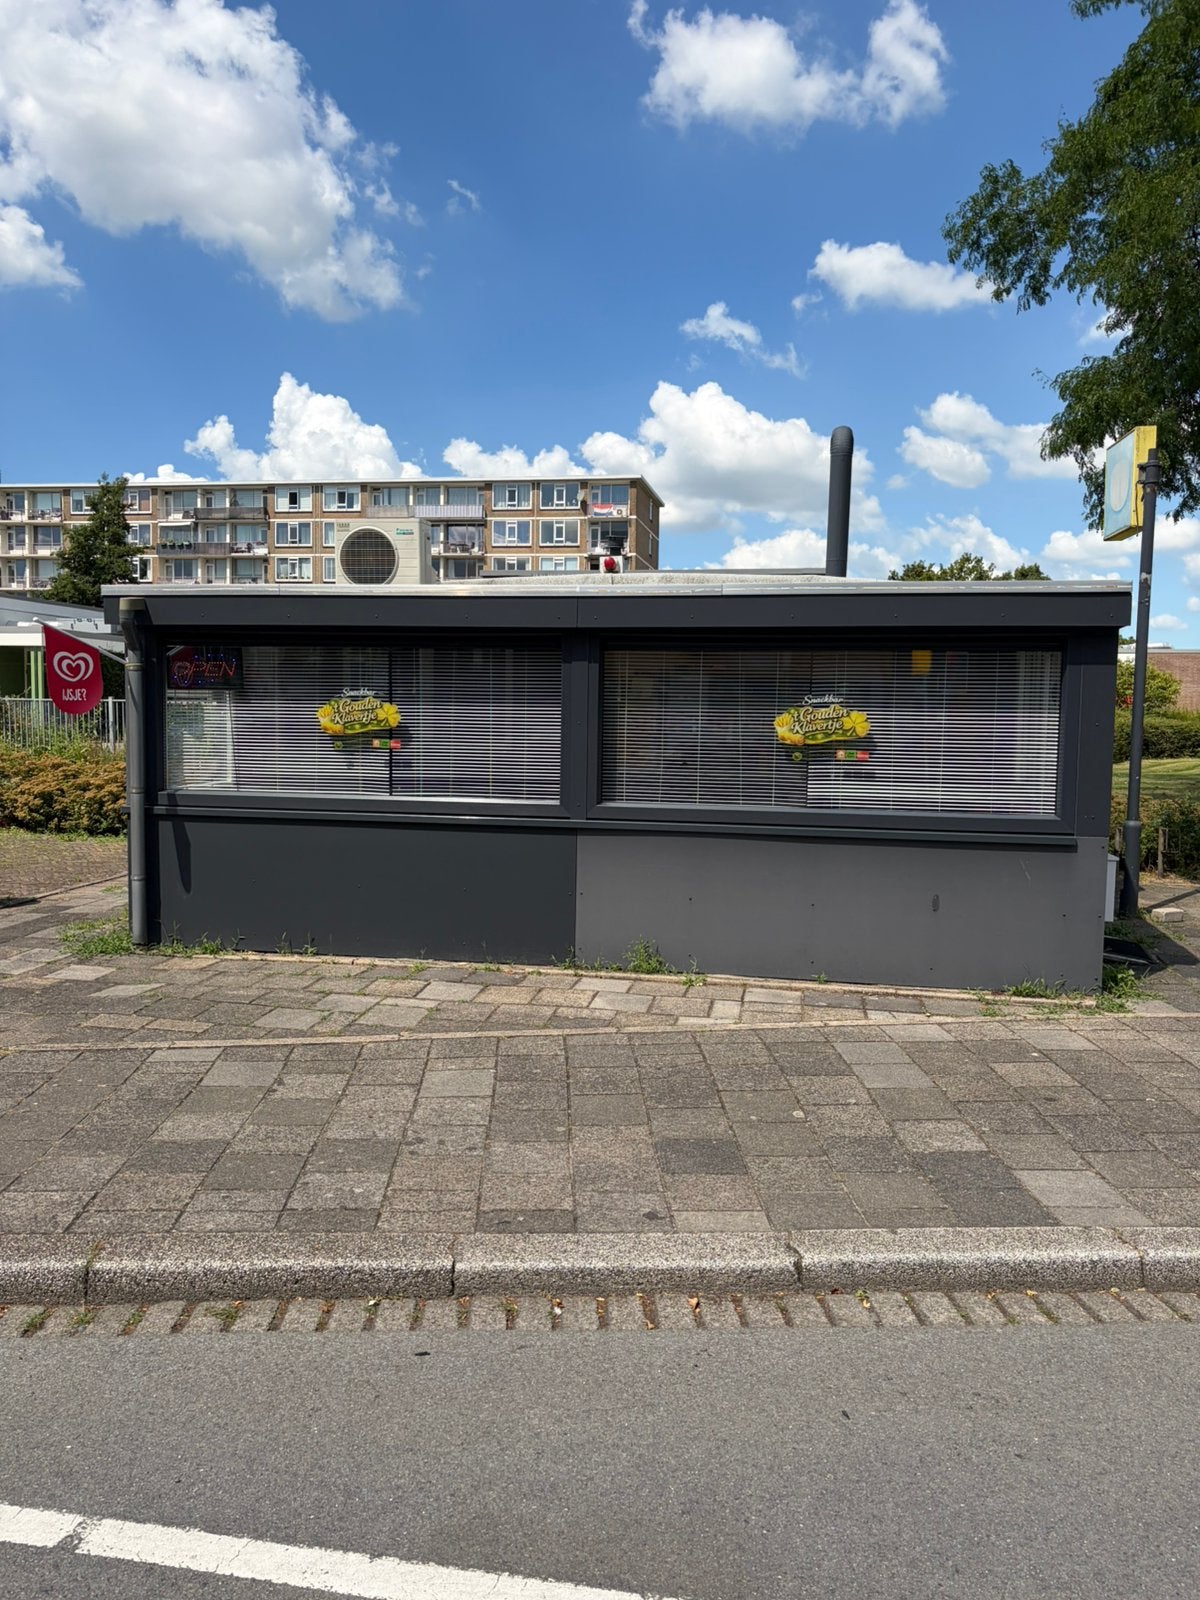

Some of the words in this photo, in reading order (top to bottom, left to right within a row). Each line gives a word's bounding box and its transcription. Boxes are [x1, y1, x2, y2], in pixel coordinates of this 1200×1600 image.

[174, 661, 236, 677] OPEN
[62, 688, 87, 701] IJSJE?
[802, 694, 844, 706] Snackbar
[340, 696, 382, 714] Gouden
[332, 709, 378, 725] Klavertje
[800, 704, 849, 723] Gouden
[791, 718, 844, 735] Klavertje
